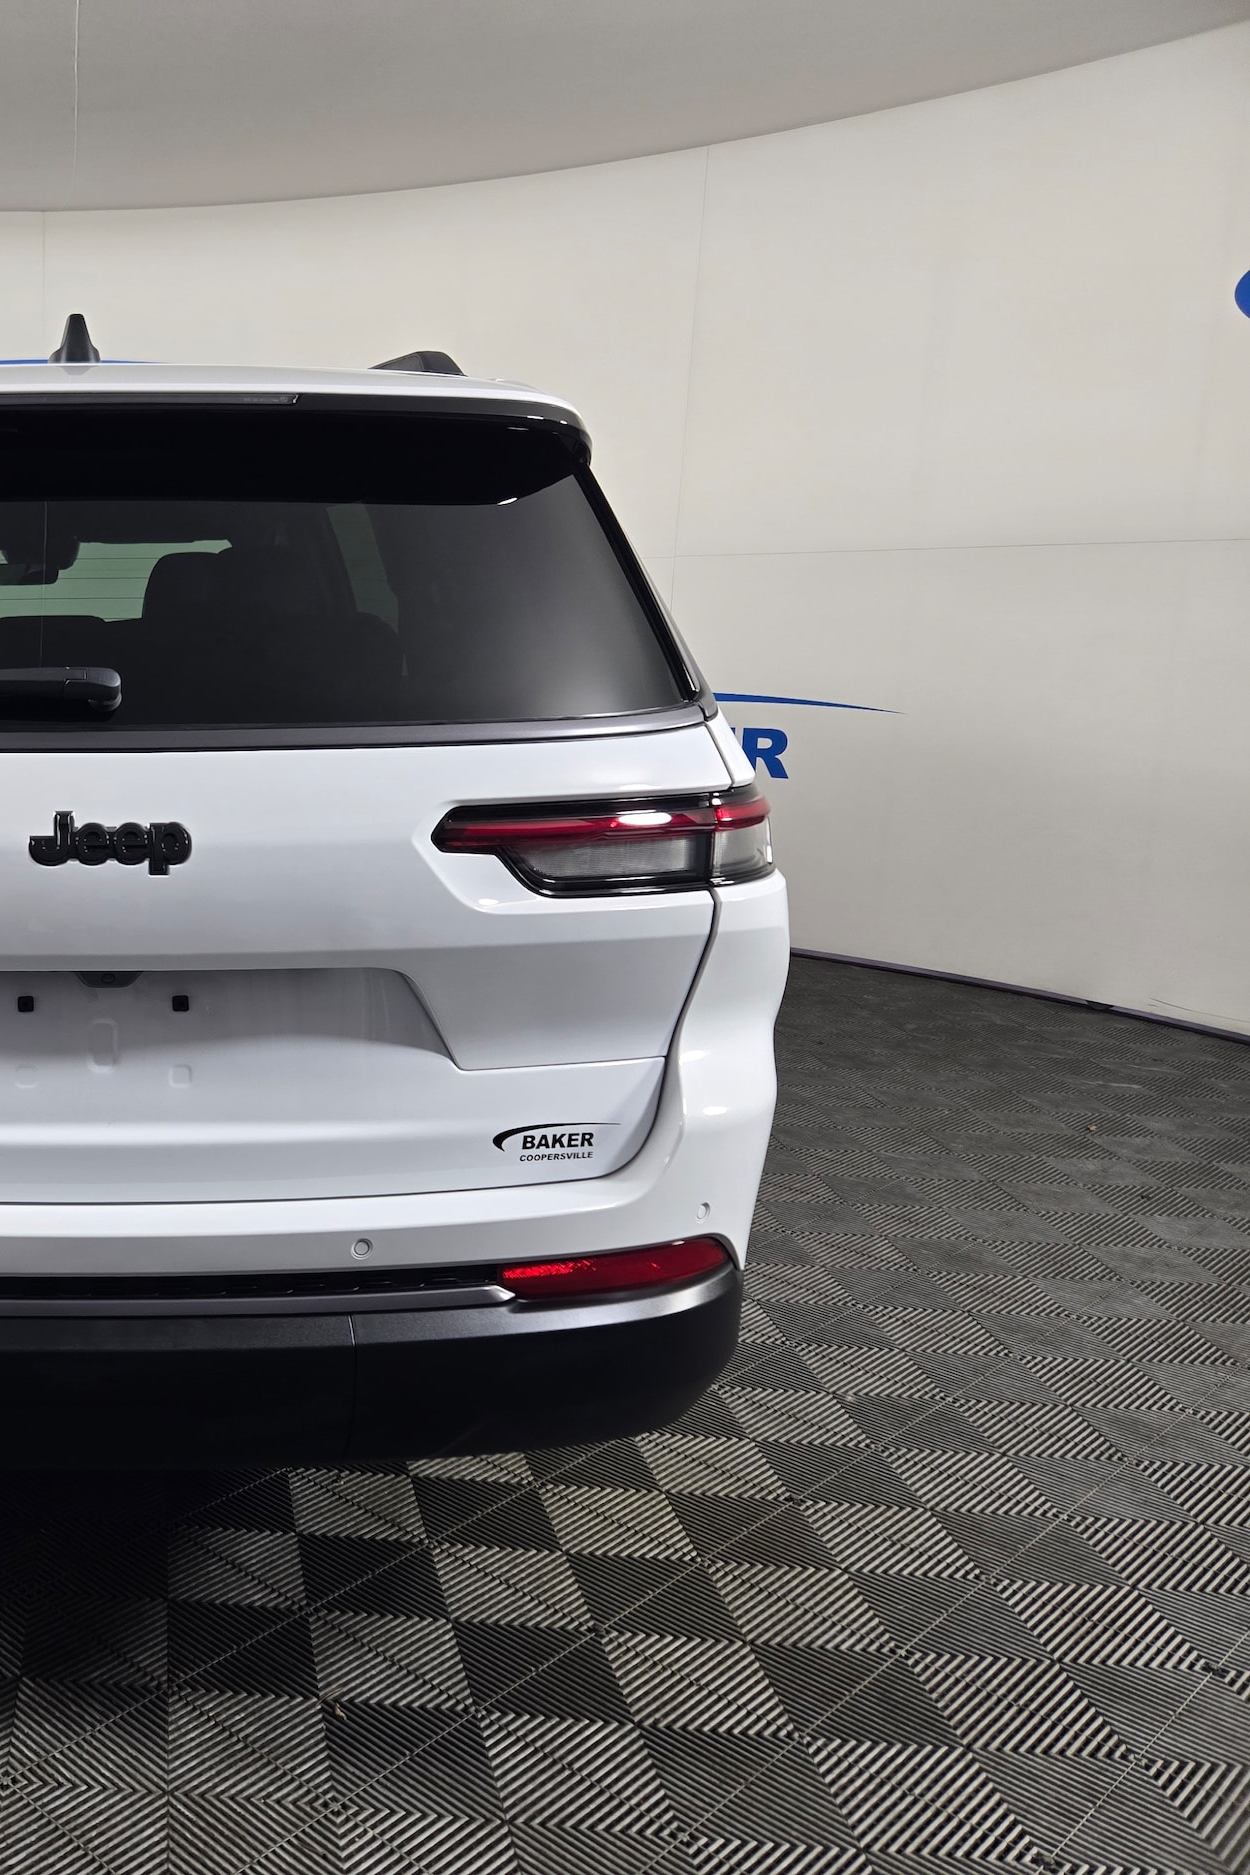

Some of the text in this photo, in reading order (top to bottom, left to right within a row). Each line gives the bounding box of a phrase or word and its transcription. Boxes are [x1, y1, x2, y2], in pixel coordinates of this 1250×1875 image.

[731, 727, 789, 779] R
[28, 810, 193, 876] Jeep
[519, 1151, 594, 1162] COOPERSVILLE
[521, 1132, 595, 1150] BAKER
